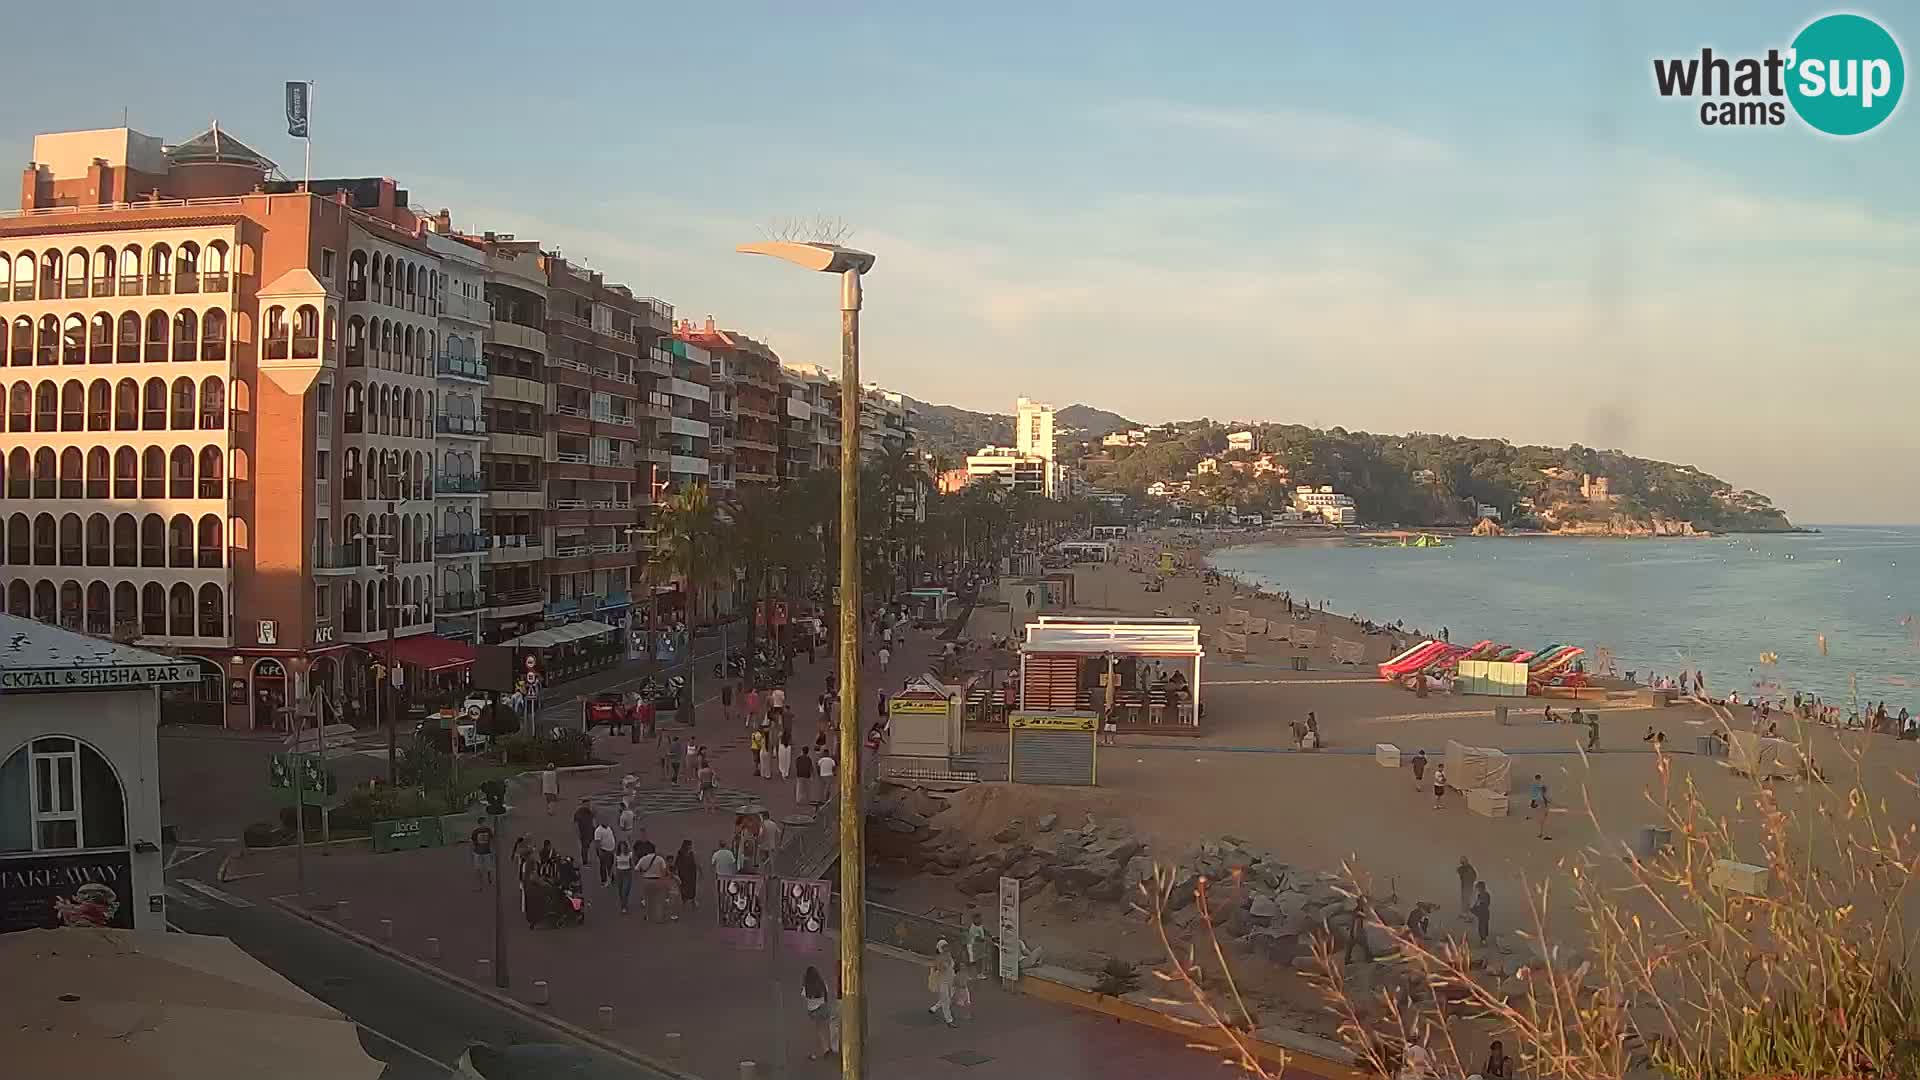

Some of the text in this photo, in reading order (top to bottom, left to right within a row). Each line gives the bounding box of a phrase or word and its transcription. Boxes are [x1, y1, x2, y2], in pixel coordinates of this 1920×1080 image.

[315, 626, 333, 643] KFC
[65, 671, 76, 684] &
[81, 668, 142, 685] SHISHA
[147, 667, 179, 682] BAR
[260, 665, 282, 675] KFC
